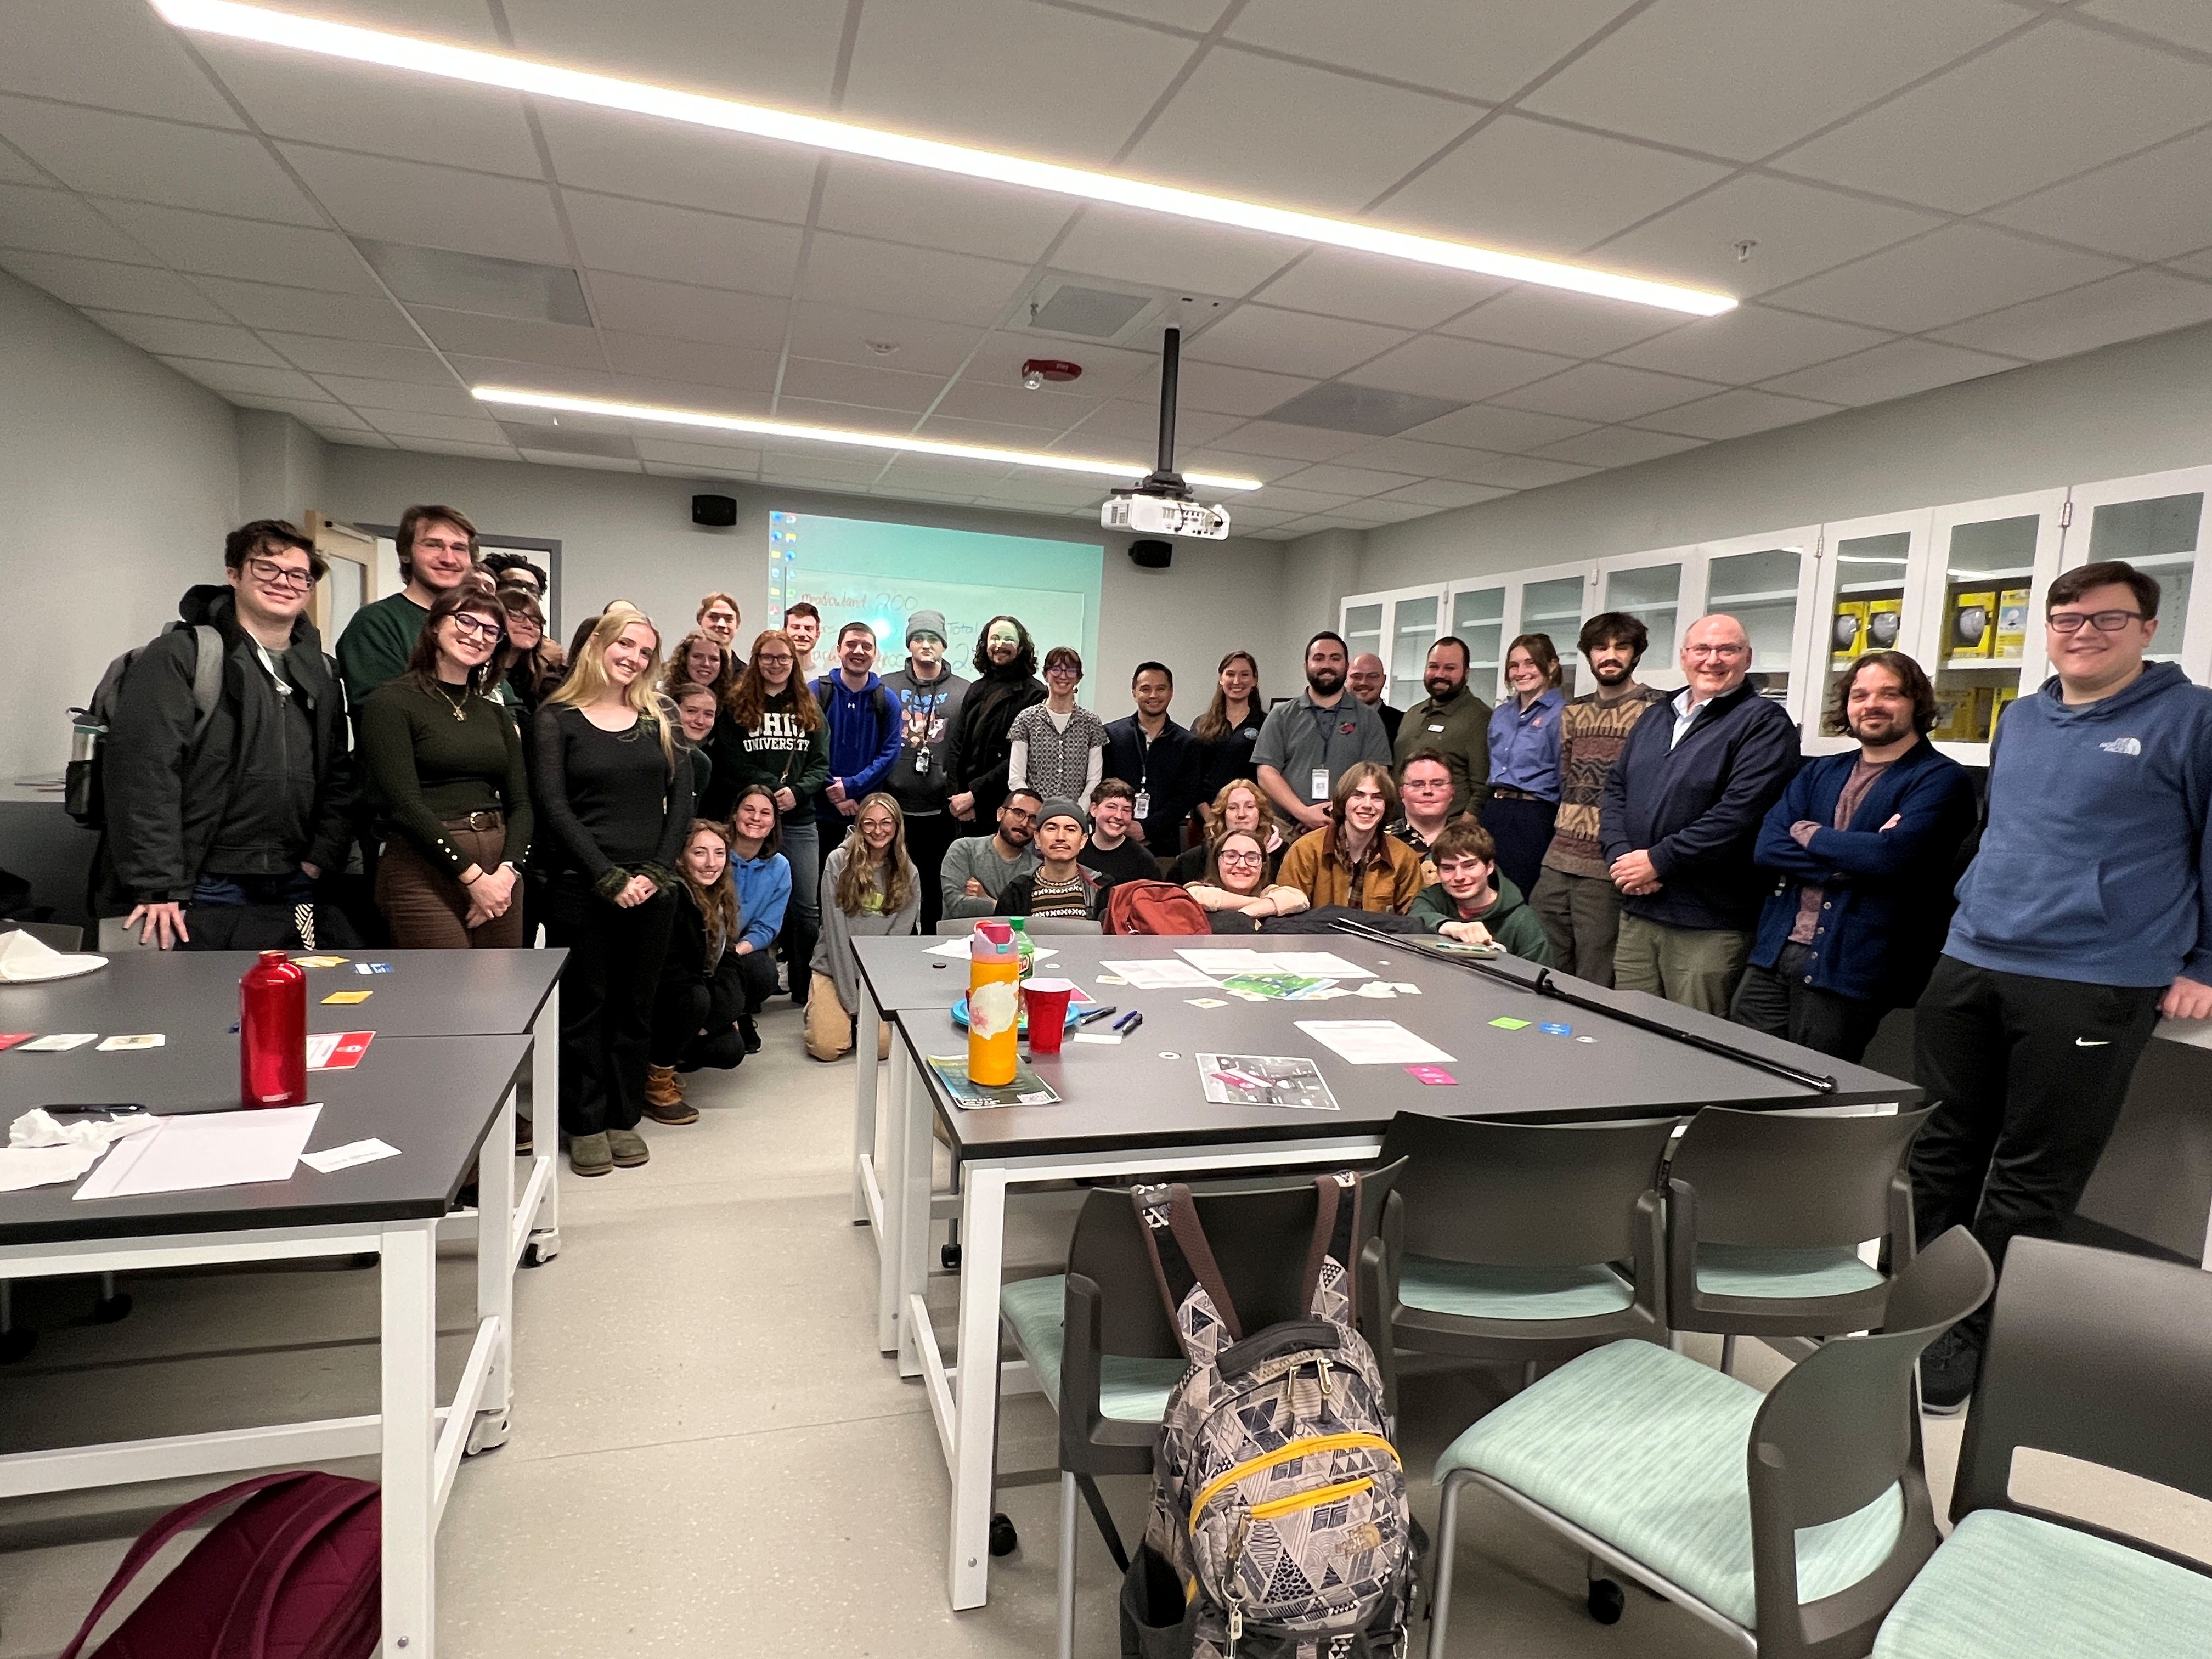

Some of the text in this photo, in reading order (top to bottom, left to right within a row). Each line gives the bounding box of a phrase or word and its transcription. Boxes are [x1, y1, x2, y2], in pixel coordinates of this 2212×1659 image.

[876, 592, 918, 611] 200
[947, 621, 978, 635] Total
[743, 737, 810, 752] UNIVERSTY
